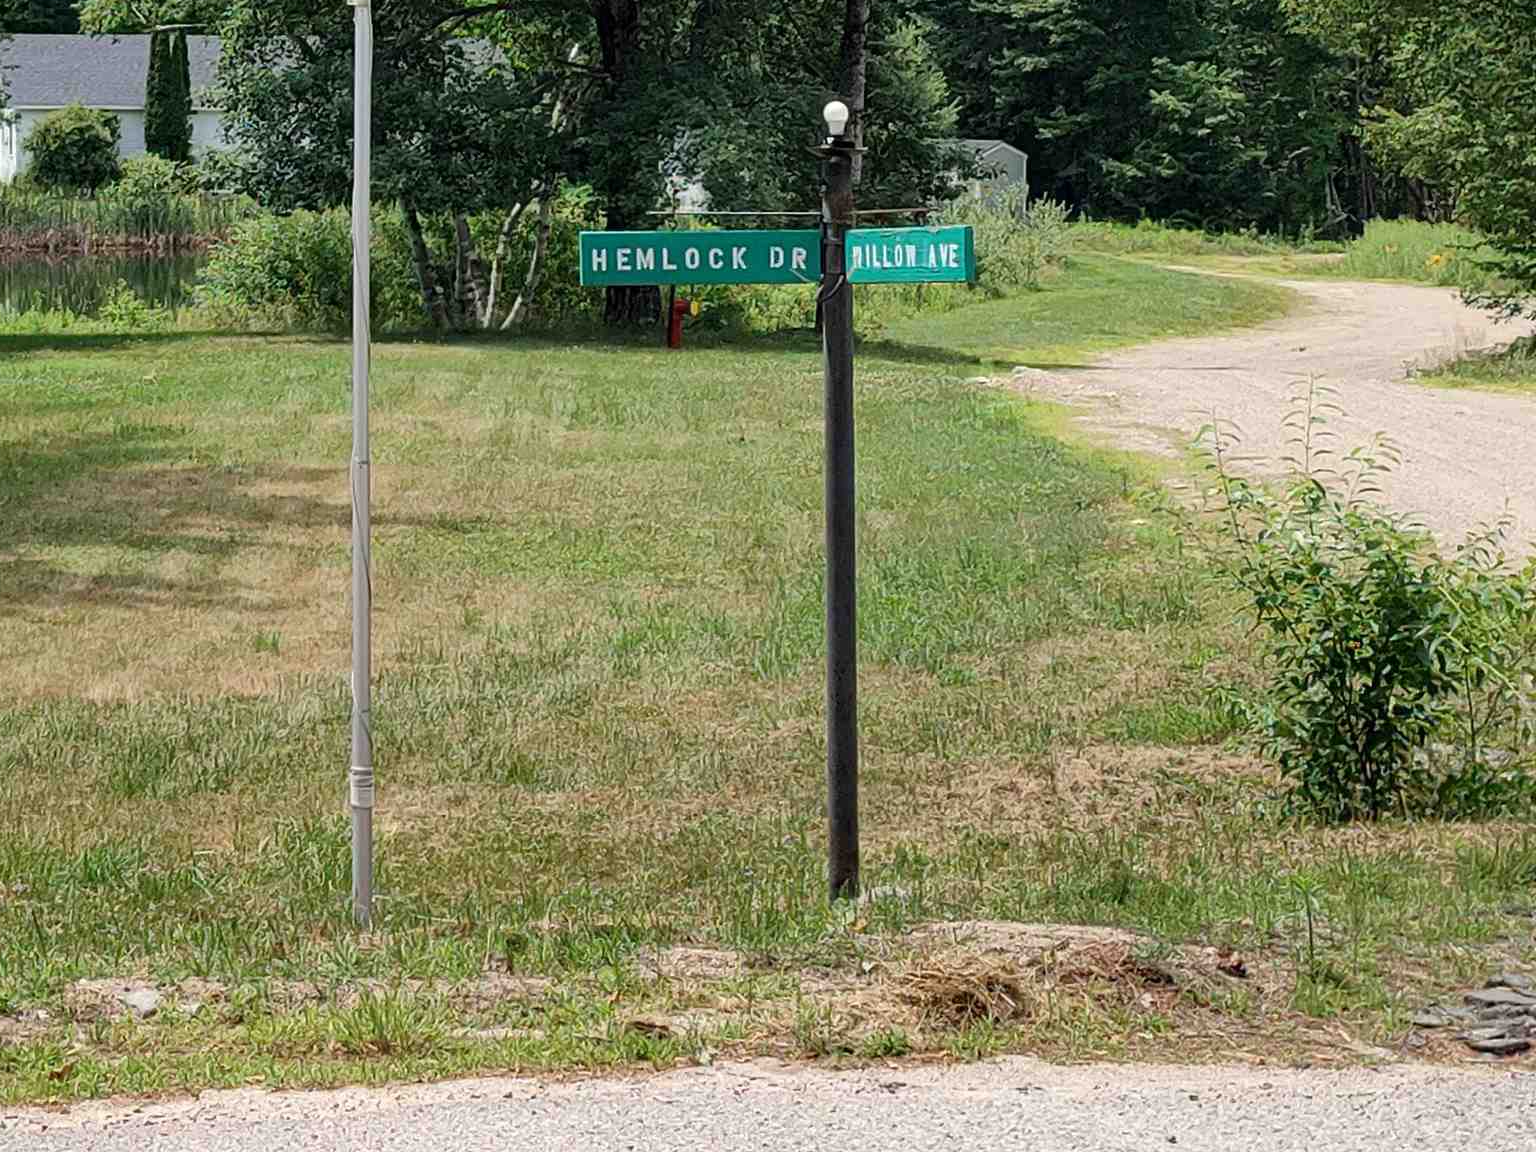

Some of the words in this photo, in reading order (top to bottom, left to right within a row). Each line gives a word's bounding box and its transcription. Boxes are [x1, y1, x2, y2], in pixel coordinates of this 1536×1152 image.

[591, 246, 748, 272] HEMLOCK
[769, 245, 808, 269] DR
[852, 244, 917, 269] WILLOW
[928, 243, 960, 268] AVE
